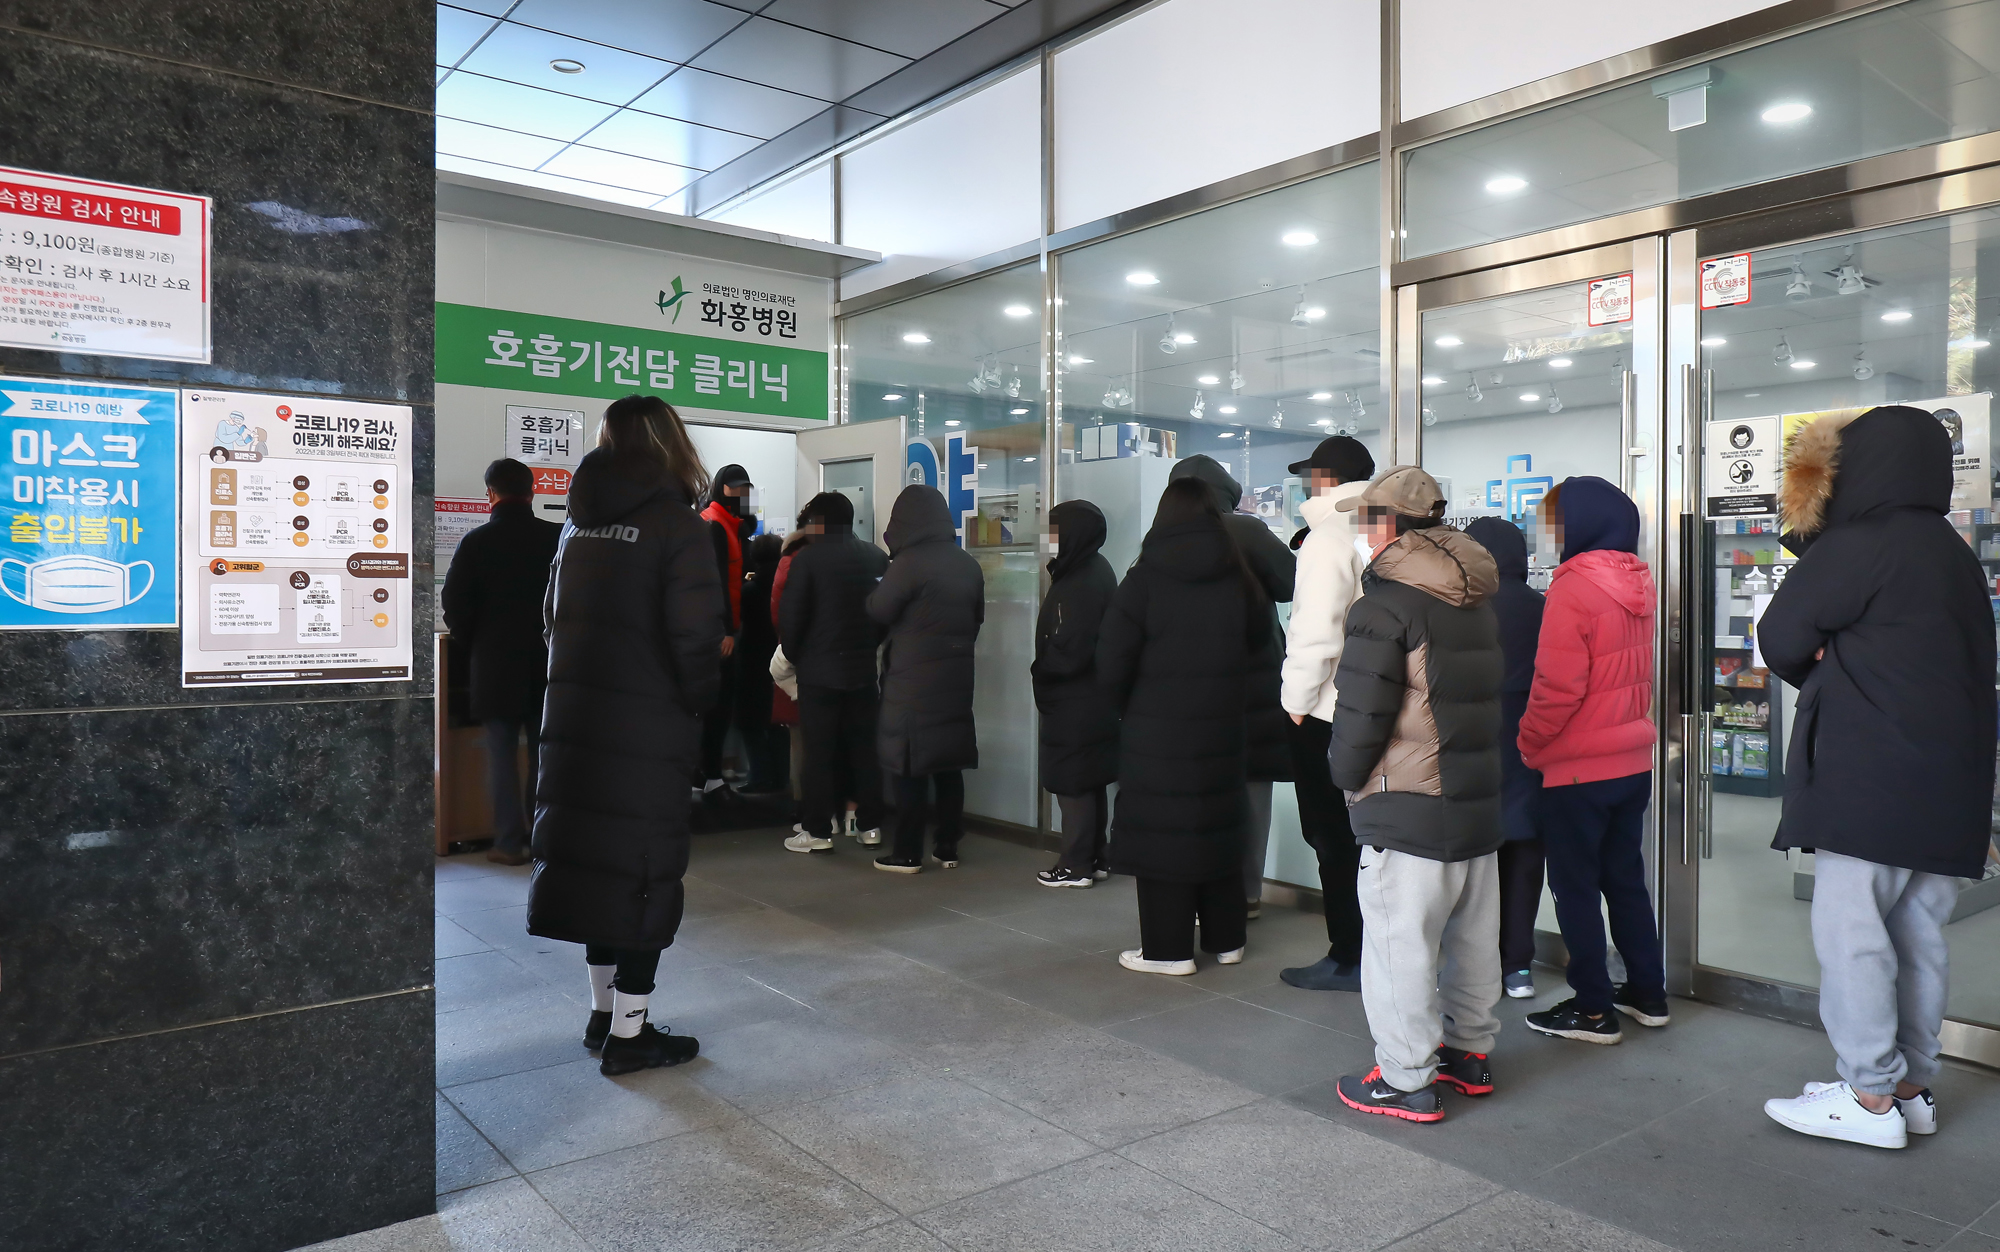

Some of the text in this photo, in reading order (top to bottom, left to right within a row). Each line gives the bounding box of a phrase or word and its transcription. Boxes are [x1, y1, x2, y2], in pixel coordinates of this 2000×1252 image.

[71, 199, 114, 222] 검사
[120, 206, 161, 229] 안내
[23, 230, 95, 255] 9,100원
[62, 264, 94, 281] 검사
[99, 268, 114, 283] 후
[119, 271, 158, 287] 1시간
[162, 277, 191, 291] 소요
[1703, 281, 1724, 292] CCTV
[39, 300, 56, 309] PCR
[702, 282, 796, 308] 의료법인 명인의료재단
[1591, 300, 1610, 310] CCTV
[700, 298, 798, 339] 화홍병원
[484, 328, 788, 403] 호흡기전담 클리닉
[30, 399, 124, 417] 코로나19 예방
[294, 414, 398, 437] 코로나19 검사,
[520, 415, 570, 436] 호흡기
[12, 429, 141, 469] 마스크
[292, 432, 397, 452] 이렇게 해주세요!
[520, 436, 570, 456] 클리닉
[12, 475, 139, 508] 미착용시
[462, 504, 475, 512] 검사
[9, 512, 144, 545] 출입불가
